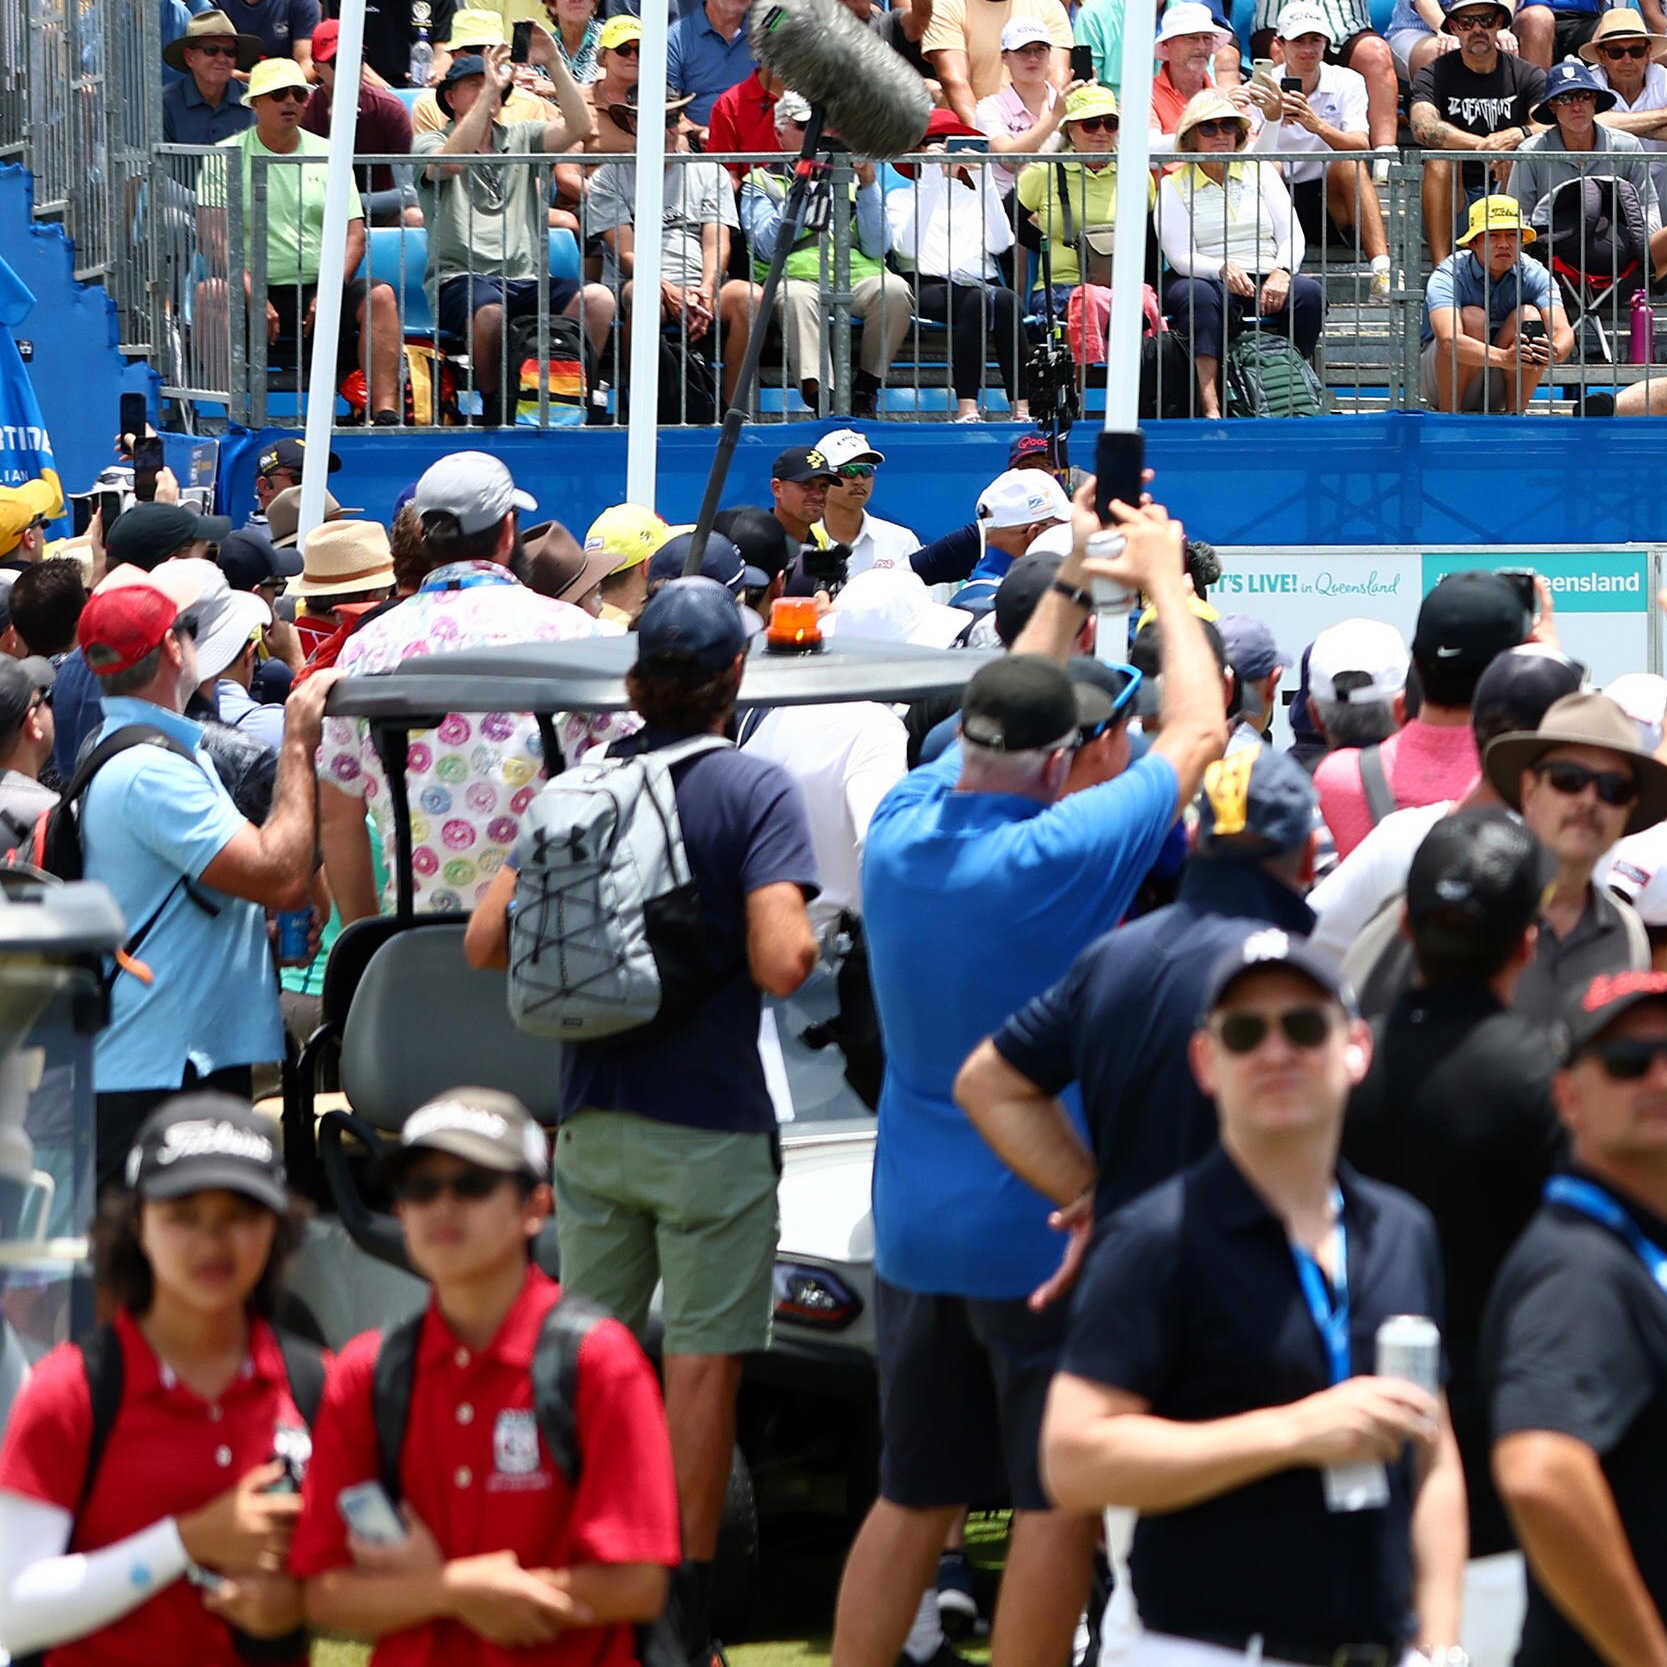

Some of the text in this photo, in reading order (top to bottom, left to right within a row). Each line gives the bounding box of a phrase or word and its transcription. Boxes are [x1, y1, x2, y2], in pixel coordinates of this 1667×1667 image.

[1248, 573, 1298, 594] LIVE!
[1301, 581, 1314, 594] in
[1313, 570, 1401, 598] Queensland
